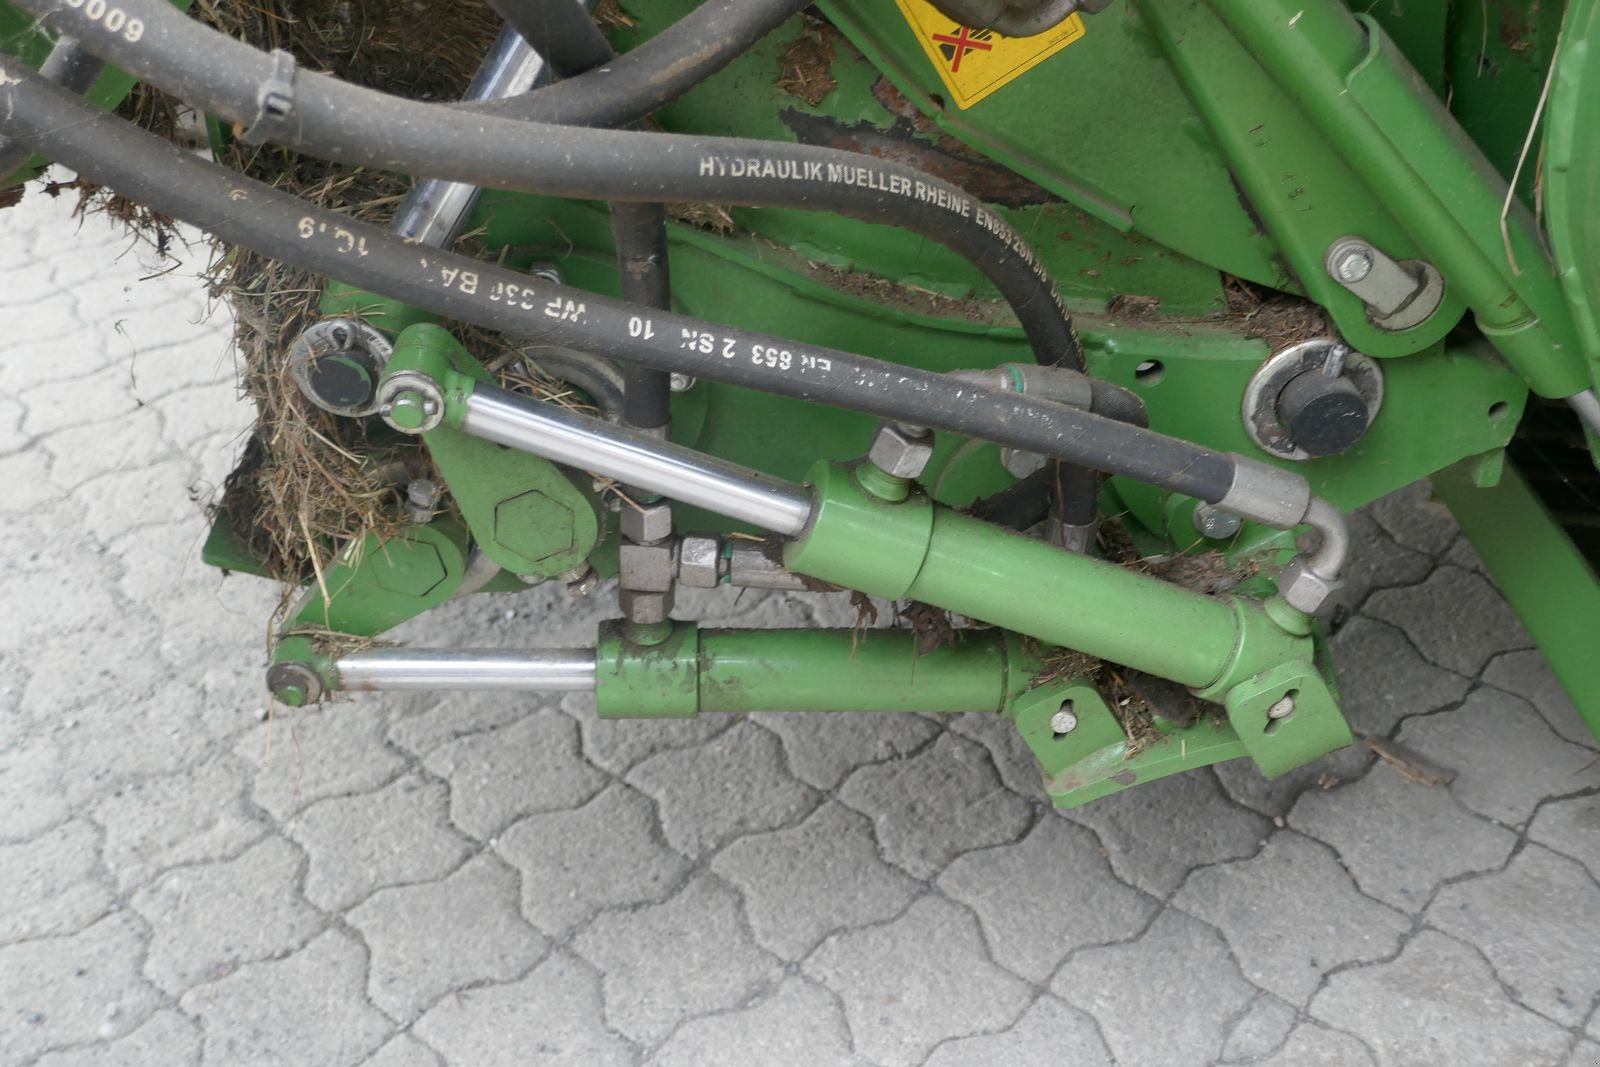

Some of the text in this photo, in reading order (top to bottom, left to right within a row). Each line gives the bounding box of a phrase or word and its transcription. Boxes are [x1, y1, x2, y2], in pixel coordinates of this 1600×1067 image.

[700, 157, 823, 181] HYDRAULIK
[827, 164, 912, 197] MUELLER
[914, 181, 971, 218] RHEINE
[628, 316, 656, 340] 10
[722, 338, 737, 359] 2
[751, 343, 793, 371] 853
